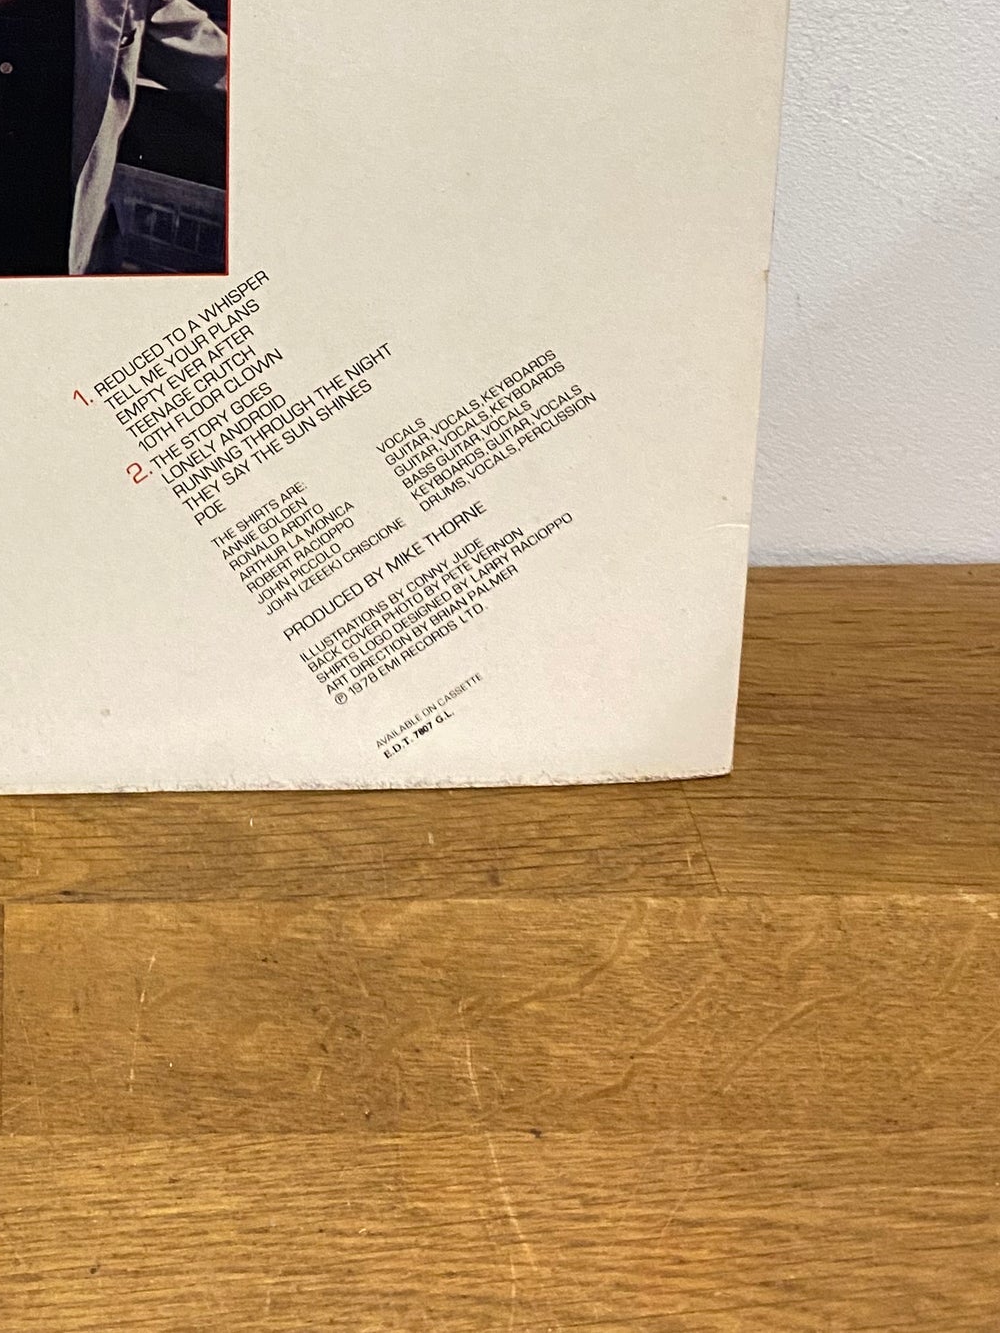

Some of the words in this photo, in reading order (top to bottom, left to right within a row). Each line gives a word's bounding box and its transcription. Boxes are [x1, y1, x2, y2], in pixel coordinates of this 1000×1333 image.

[73, 390, 94, 406] 1.
[94, 343, 165, 397] REDUCED
[162, 327, 187, 347] TO
[188, 320, 202, 334] A
[197, 270, 270, 323] WHISPER
[103, 384, 143, 410] TELL
[139, 363, 168, 387] ME
[163, 334, 210, 368] YOUR
[207, 299, 260, 340] PLANS
[115, 383, 166, 426] EMPTY
[166, 357, 207, 390] EVER
[208, 325, 255, 364] AFTER
[126, 387, 195, 438] TEENAGE
[193, 345, 256, 393] CRUTCH
[126, 462, 153, 484] 2.
[149, 443, 183, 469] THE
[180, 409, 229, 450] STORY
[230, 382, 273, 416] GOES
[138, 421, 177, 452] 10TH
[174, 388, 226, 428] FLOOR
[223, 348, 284, 394] CLOWN
[161, 439, 217, 485] LONELY
[220, 394, 286, 447] ANDROID
[172, 445, 243, 499] RUNNING
[240, 395, 316, 450] THROUGH
[313, 374, 347, 400] THE
[344, 342, 392, 381] NIGHT
[376, 418, 426, 453] VOCALS
[182, 479, 221, 511] THEY
[222, 459, 251, 486] SAY
[250, 438, 284, 464] THE
[281, 416, 317, 445] SUN
[316, 379, 372, 422] SHINES
[402, 462, 437, 489] BASS
[194, 499, 227, 526] POE
[210, 527, 237, 548] THE
[235, 499, 280, 532] SHIRTS
[222, 530, 259, 561] ANNIE
[257, 497, 308, 535] GOLDEN
[229, 533, 280, 571] RONALD
[281, 503, 324, 538] ARDITO
[240, 545, 289, 582] ARTHUR
[286, 534, 306, 549] LA
[303, 501, 355, 538] MONICA
[246, 556, 293, 594] ROBERT
[293, 517, 355, 562] RACIOPPO
[258, 576, 291, 605] JOHN
[289, 543, 341, 582] PICCOLO
[267, 588, 299, 616] JOHN
[342, 517, 406, 563] CRISCIONE
[283, 582, 364, 642] PRODUCED
[363, 566, 384, 588] BY
[385, 541, 426, 574] MIKE
[422, 500, 487, 547] THORNE
[299, 600, 389, 663] ILLUSTRATIONS
[388, 588, 405, 605] BY
[406, 559, 449, 593] CONNY
[453, 537, 484, 564] JUDE
[307, 646, 343, 673] BACK
[341, 620, 383, 650] COVER
[381, 592, 424, 624] PHOTO
[423, 580, 440, 597] BY
[441, 560, 473, 586] PETE
[471, 527, 524, 564] VERNON
[316, 651, 360, 684] SHIRTS
[358, 629, 393, 656] LOGO
[392, 591, 452, 634] DESIGNED
[452, 578, 469, 595] BY
[469, 552, 509, 583] LARRY
[510, 513, 573, 557] RACIOPPO
[326, 673, 349, 695] ART
[349, 632, 413, 679] DIRECTION
[411, 621, 429, 638] BY
[429, 596, 468, 627] BRIAN
[466, 564, 519, 602] PALMER
[348, 672, 379, 695] 1978
[377, 657, 402, 677] EMI
[400, 620, 458, 662] RECORDS
[376, 713, 422, 749] AVAILABLE
[421, 703, 438, 717] ON
[437, 672, 483, 707] CASSETTE
